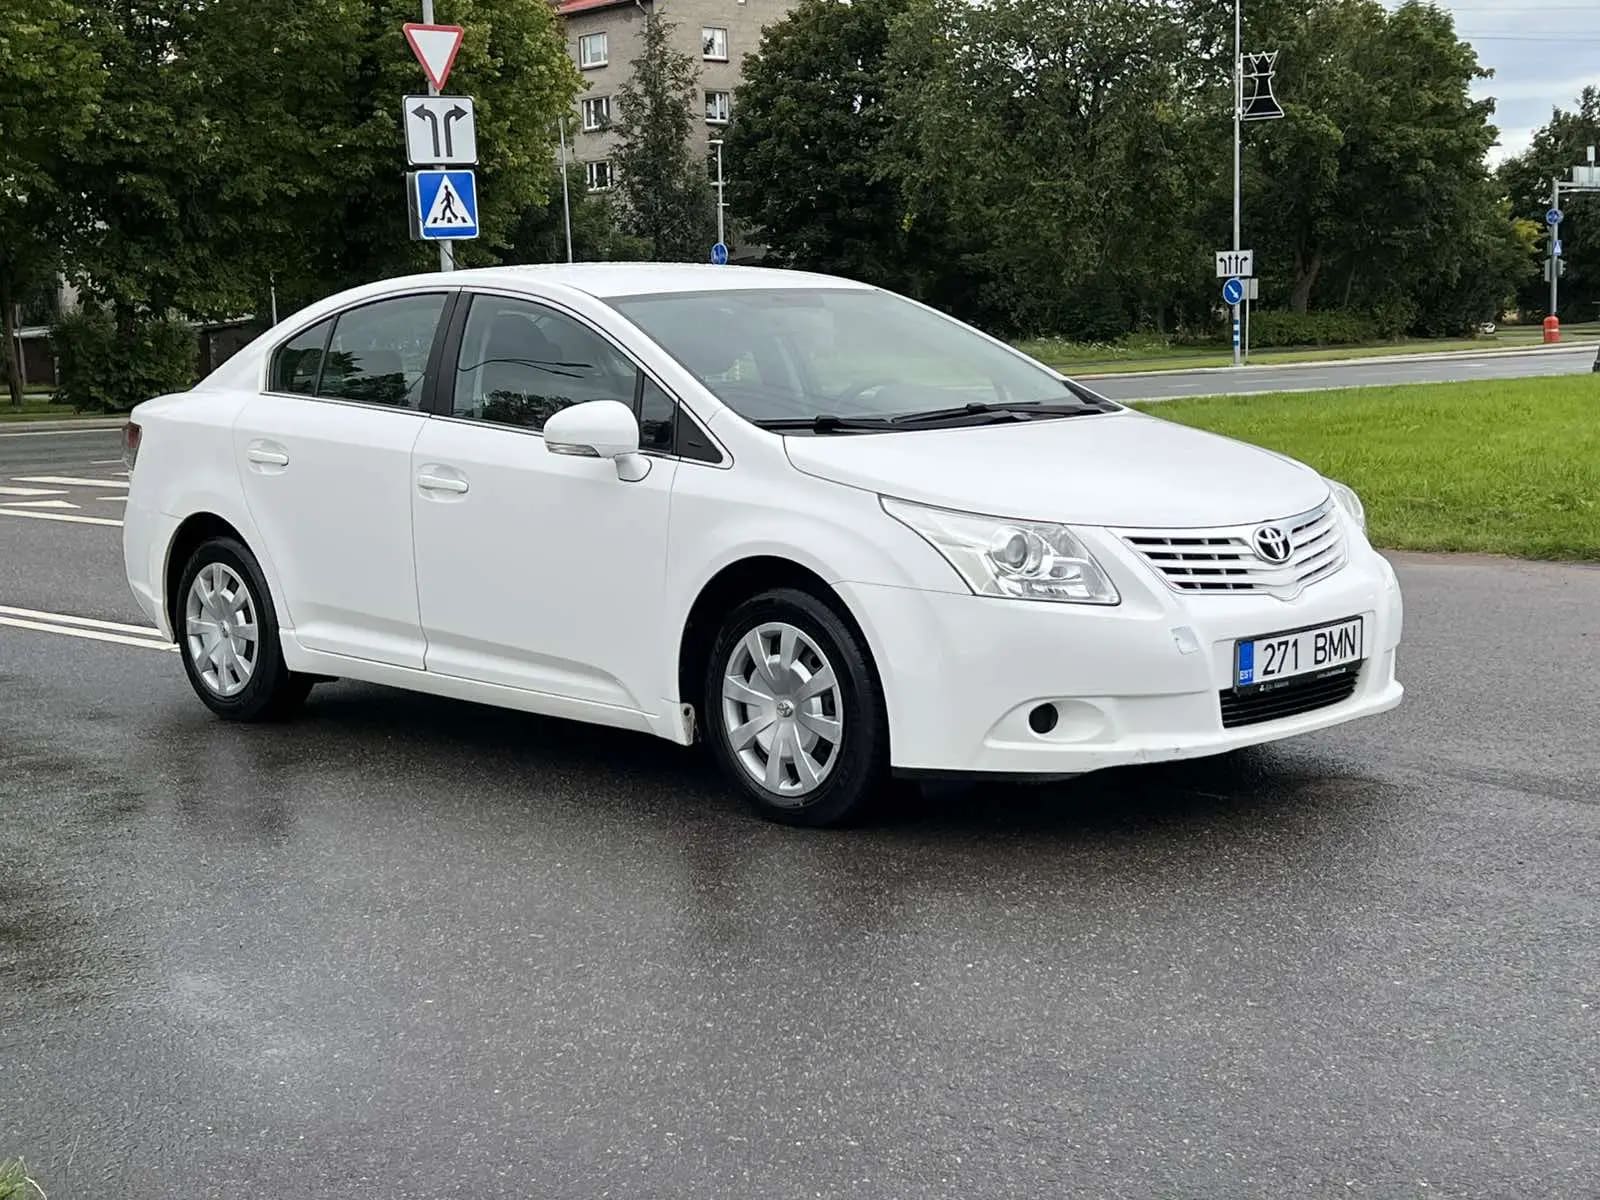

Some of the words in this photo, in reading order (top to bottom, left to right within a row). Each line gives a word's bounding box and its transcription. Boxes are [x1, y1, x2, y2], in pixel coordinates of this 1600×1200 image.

[1262, 639, 1298, 676] 271
[1314, 625, 1356, 665] BMN
[1239, 670, 1253, 681] EST
